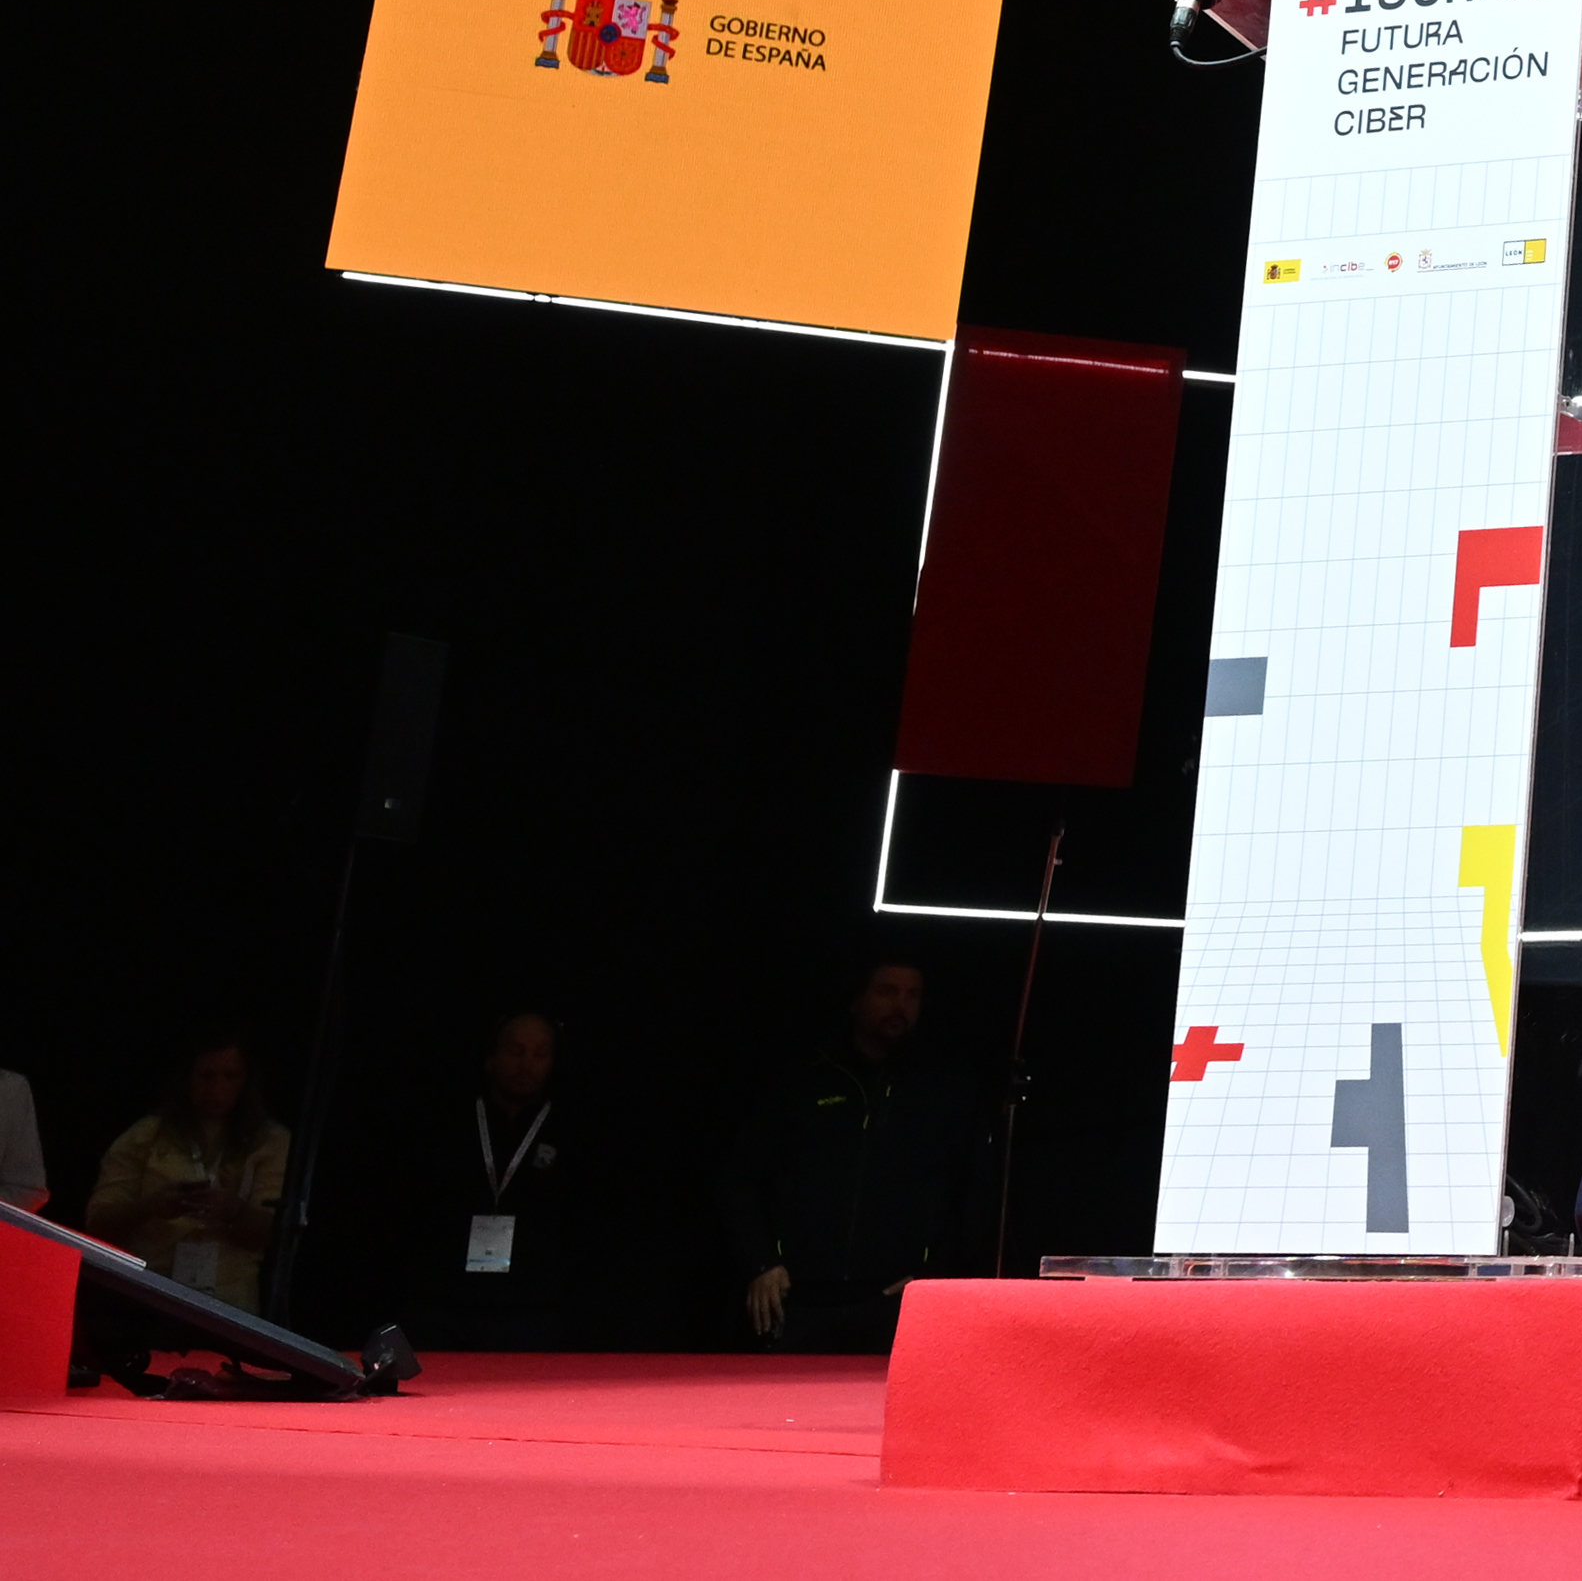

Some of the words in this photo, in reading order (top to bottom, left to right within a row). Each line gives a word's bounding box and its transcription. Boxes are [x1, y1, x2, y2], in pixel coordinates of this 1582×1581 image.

[709, 15, 826, 47] GOBIERNO
[1341, 19, 1463, 55] FUTURA
[705, 38, 736, 59] DE
[741, 43, 826, 72] ESPAÑA
[1338, 47, 1549, 95] GENERACIÓN
[1334, 104, 1426, 136] CIBER
